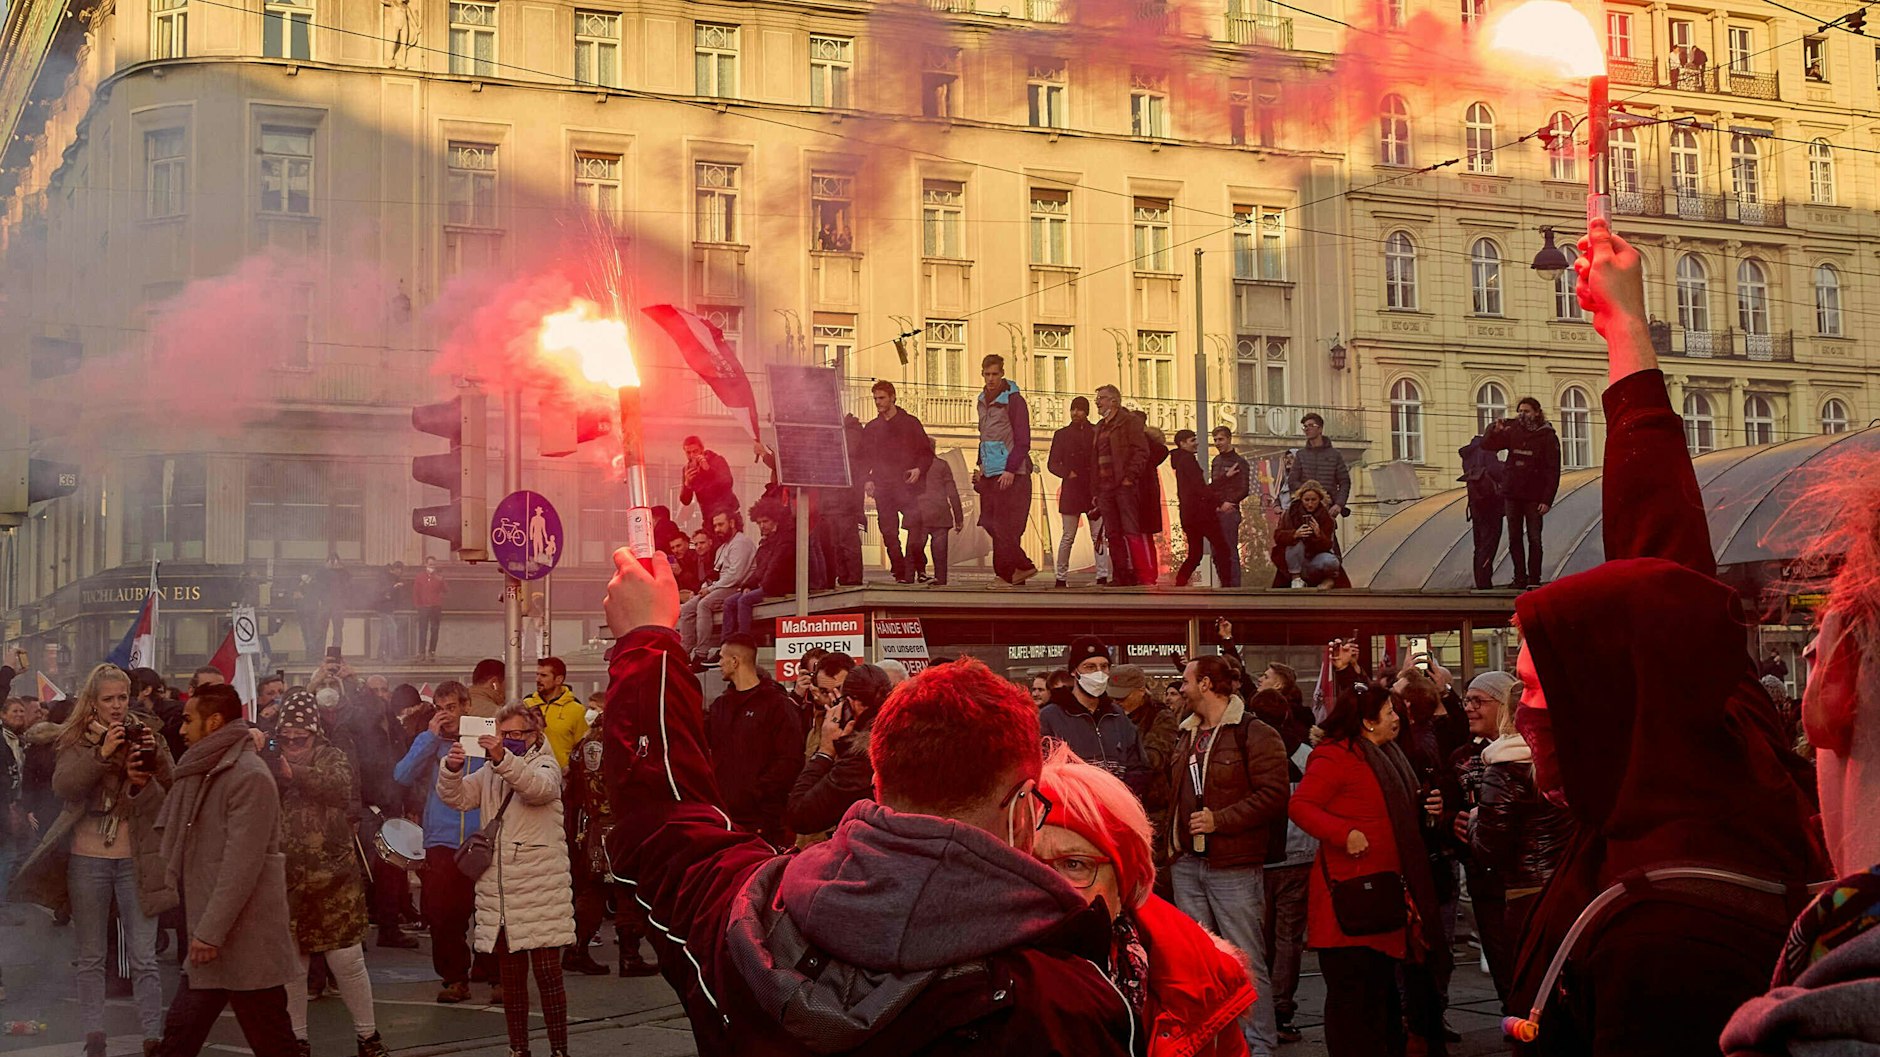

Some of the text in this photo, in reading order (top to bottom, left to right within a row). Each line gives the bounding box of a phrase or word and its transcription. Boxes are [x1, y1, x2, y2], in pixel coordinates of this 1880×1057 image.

[60, 474, 75, 486] 36
[82, 585, 201, 604] TUCHLAUBN EIS
[782, 619, 858, 634] Maßnahmen
[876, 621, 921, 634] HÄNDE WEG
[883, 644, 925, 653] von unseren
